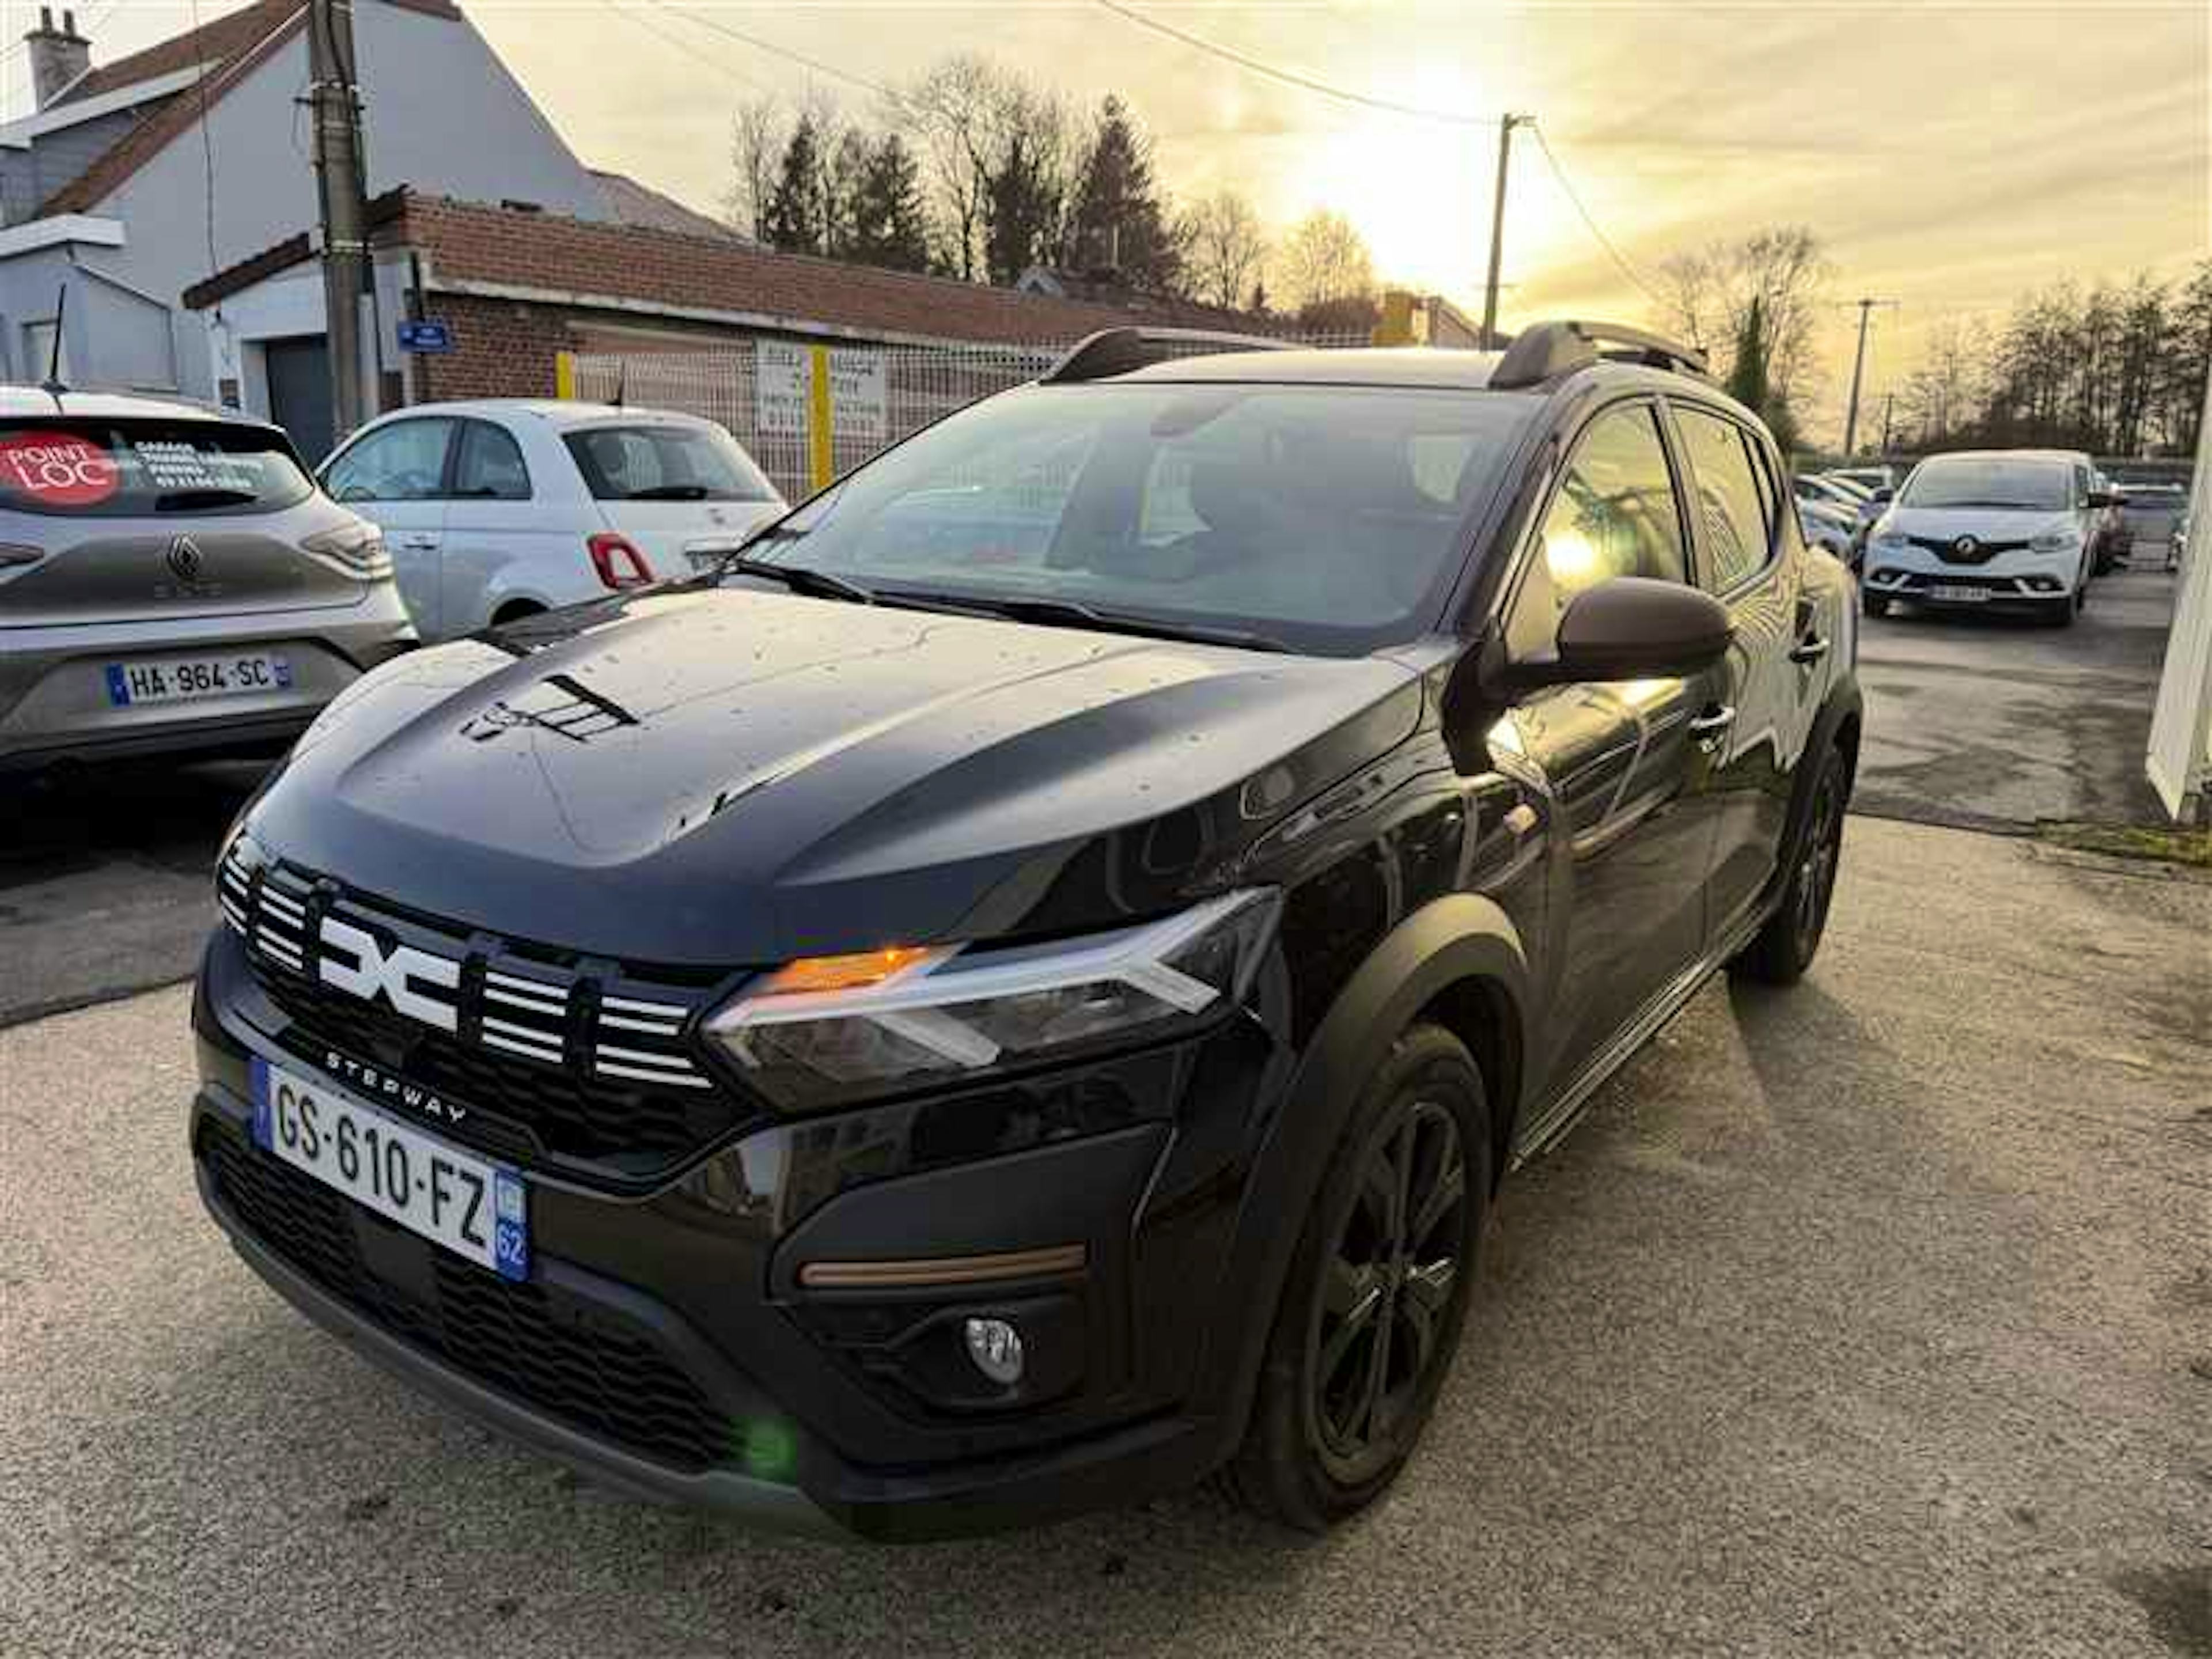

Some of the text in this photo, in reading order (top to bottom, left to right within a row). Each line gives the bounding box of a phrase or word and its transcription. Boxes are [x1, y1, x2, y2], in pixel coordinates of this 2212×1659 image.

[7, 444, 89, 465] POINT
[16, 460, 108, 488] LOC
[326, 1052, 466, 1123] STEPWAY
[278, 1084, 489, 1247] GS-610-FZ
[497, 1222, 525, 1266] 62
